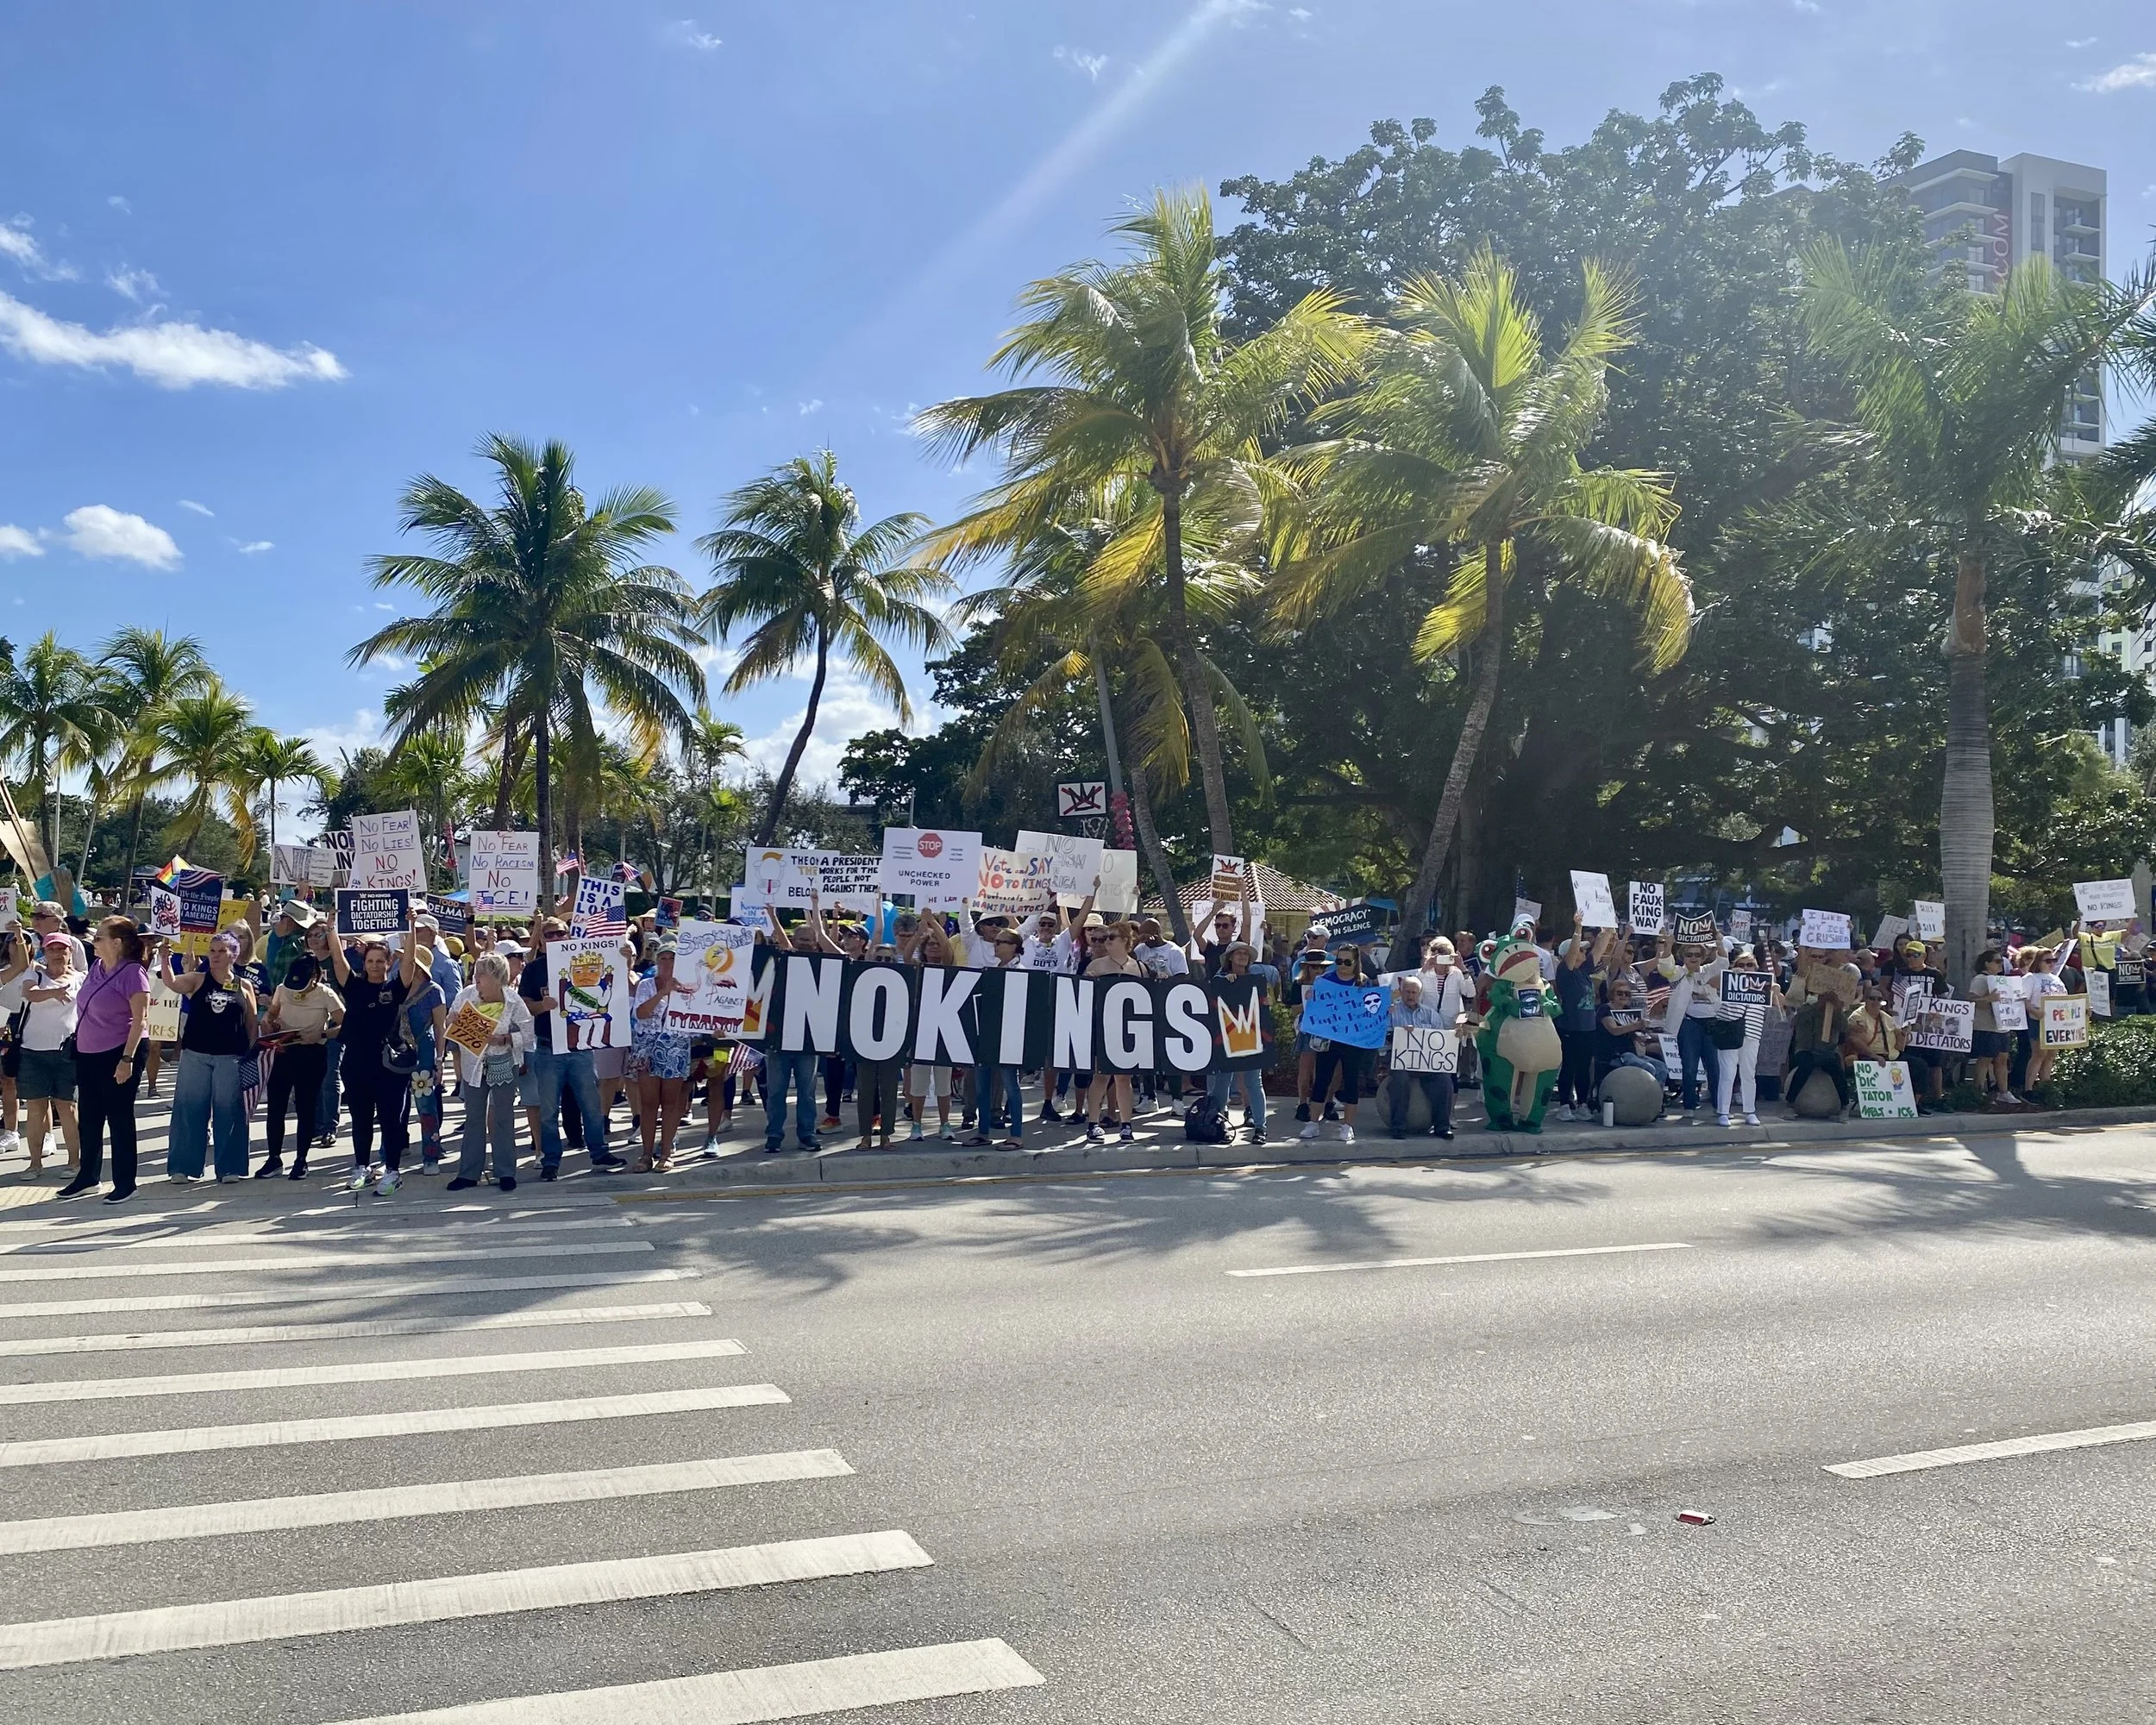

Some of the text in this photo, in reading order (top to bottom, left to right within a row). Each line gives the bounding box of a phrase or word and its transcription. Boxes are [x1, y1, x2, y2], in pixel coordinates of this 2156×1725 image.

[502, 837, 528, 850] FEAR
[918, 841, 942, 850] STOP
[1045, 835, 1075, 854] NO
[375, 856, 398, 869] NO
[495, 855, 534, 868] RACISM
[791, 856, 808, 865] THE
[820, 857, 830, 866] A
[832, 857, 882, 866] PRESIDENT
[984, 853, 1012, 874] Vote
[1028, 856, 1053, 875] SAY
[367, 869, 416, 888] KINGS!
[899, 870, 950, 880] UNCHECKED
[581, 879, 619, 895] THIS
[823, 884, 856, 893] AGAINST
[1639, 882, 1656, 894] NO
[200, 892, 219, 902] People
[580, 891, 611, 906] IS A
[191, 904, 218, 914] KINGS
[350, 899, 398, 912] FIGHTING
[973, 900, 1045, 913] MANIPULATORS
[1633, 905, 1662, 917] KING
[185, 912, 216, 921] AMERICA
[351, 911, 398, 919] DICTATORSHIP
[1821, 913, 1843, 922] LIKE
[352, 919, 398, 930] TOGETHER
[1343, 921, 1371, 934] SILENCE
[1635, 917, 1658, 928] WAY
[1678, 919, 1699, 935] NO
[1827, 925, 1844, 934] ICE
[1677, 932, 1714, 941] DICTATORS
[1807, 932, 1849, 943] CRUSHED
[580, 940, 618, 950] KINGS!
[1727, 974, 1750, 992] NO
[714, 995, 745, 1005] AGAINST
[1727, 992, 1766, 1003] DICTATORS
[1929, 999, 1970, 1014] KINGS
[451, 1028, 482, 1048] 1776
[1407, 1029, 1445, 1051] NO
[1915, 1032, 1971, 1050] DICTATORS
[1394, 1049, 1456, 1070] KINGS
[1857, 1063, 1871, 1074] NO
[1862, 1091, 1893, 1101] TATOR
[1897, 1107, 1915, 1118] ICE
